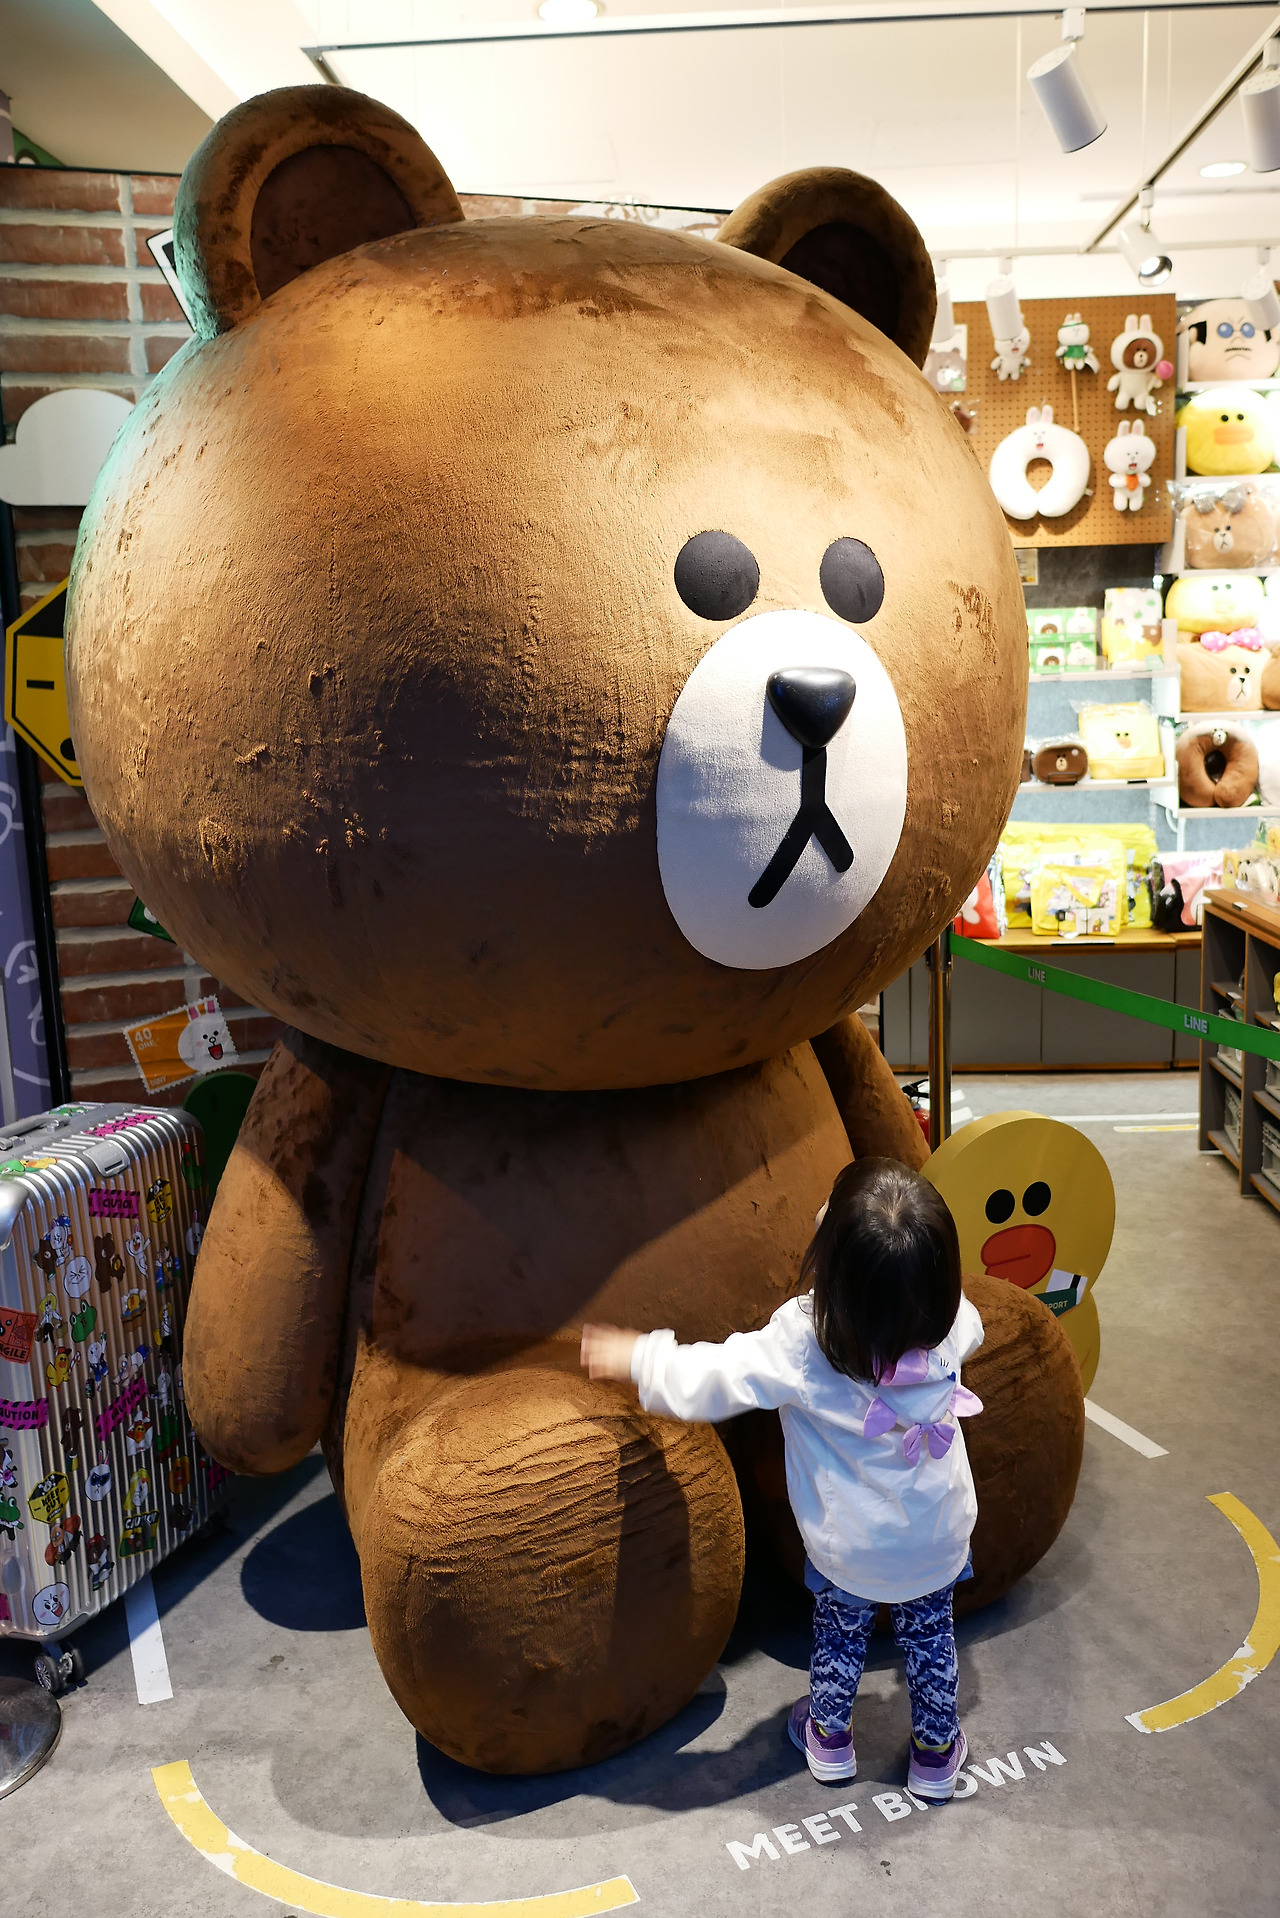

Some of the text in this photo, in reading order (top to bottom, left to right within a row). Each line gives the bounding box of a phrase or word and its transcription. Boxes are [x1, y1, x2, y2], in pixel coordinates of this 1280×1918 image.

[1027, 966, 1046, 984] LINE
[1183, 1013, 1209, 1034] LINE
[135, 1027, 152, 1043] 40
[41, 1487, 60, 1507] KEEP
[45, 1496, 61, 1513] OUT
[725, 1740, 1068, 1871] MEET BOWN
